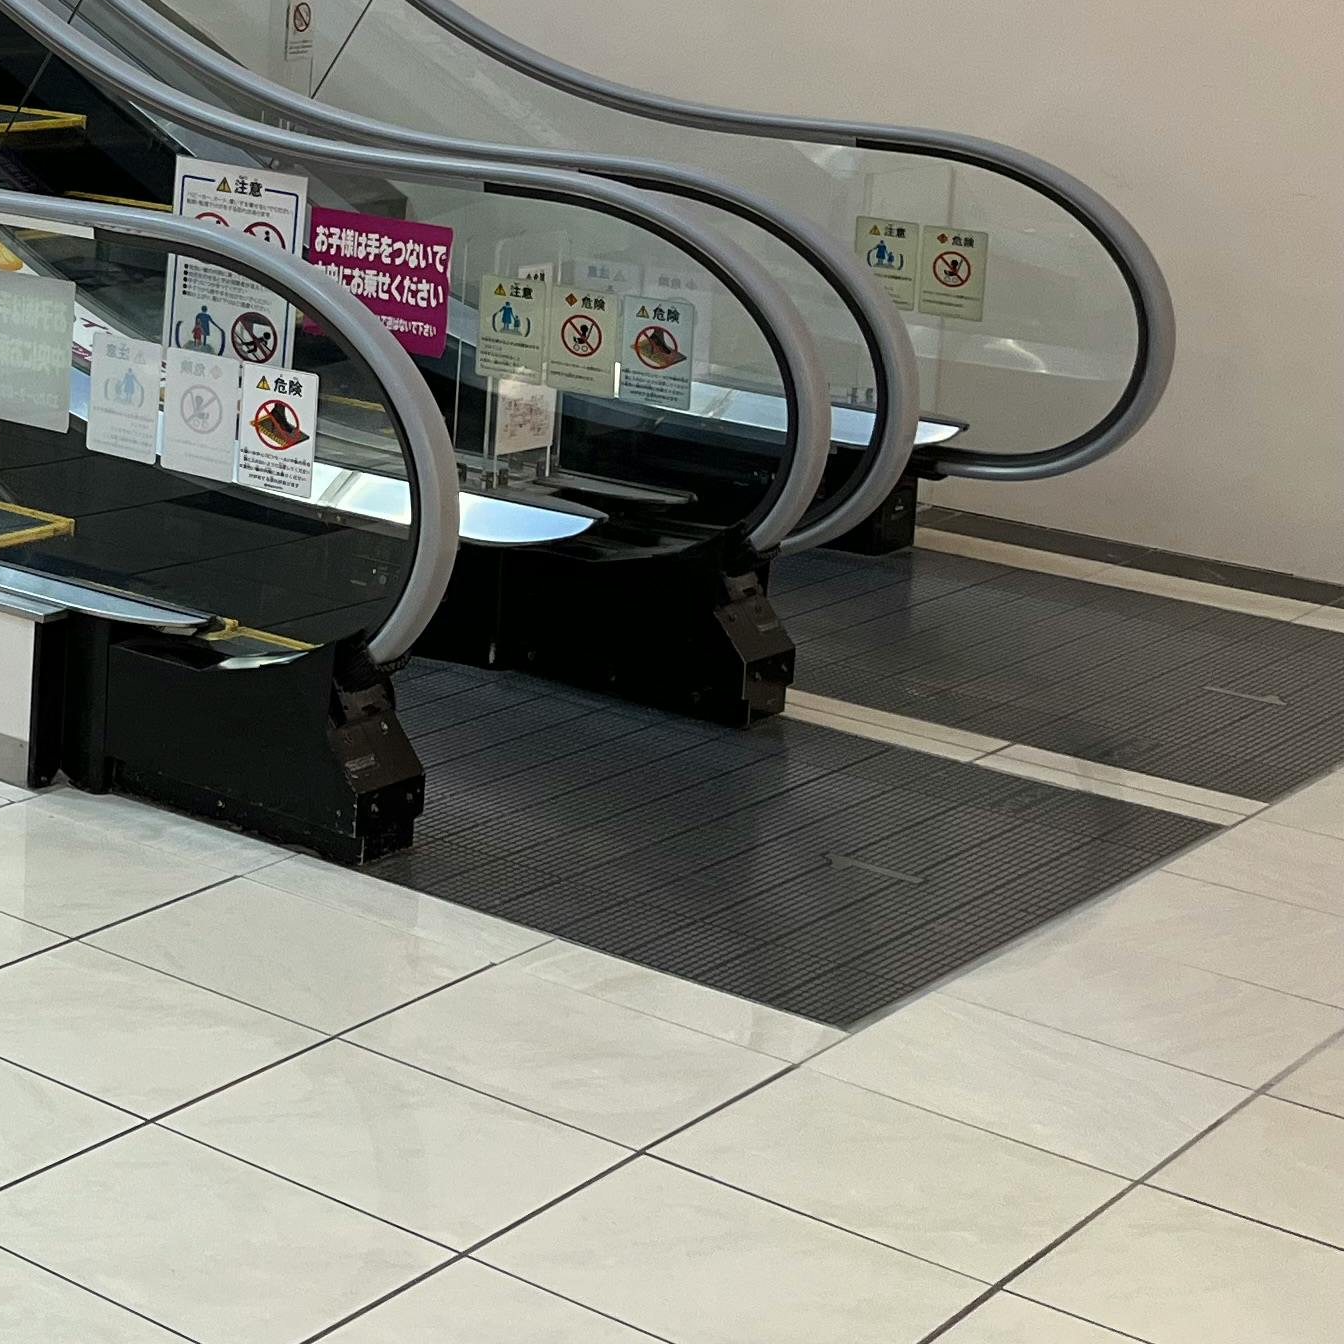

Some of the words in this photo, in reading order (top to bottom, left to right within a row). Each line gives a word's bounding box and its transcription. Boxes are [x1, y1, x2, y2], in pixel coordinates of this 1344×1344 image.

[234, 178, 263, 198] 注意
[314, 224, 448, 274] お子様は手をつないで
[509, 283, 534, 300] 注意
[581, 295, 606, 312] 危険
[652, 305, 681, 325] 危険
[273, 376, 304, 398] 危険
